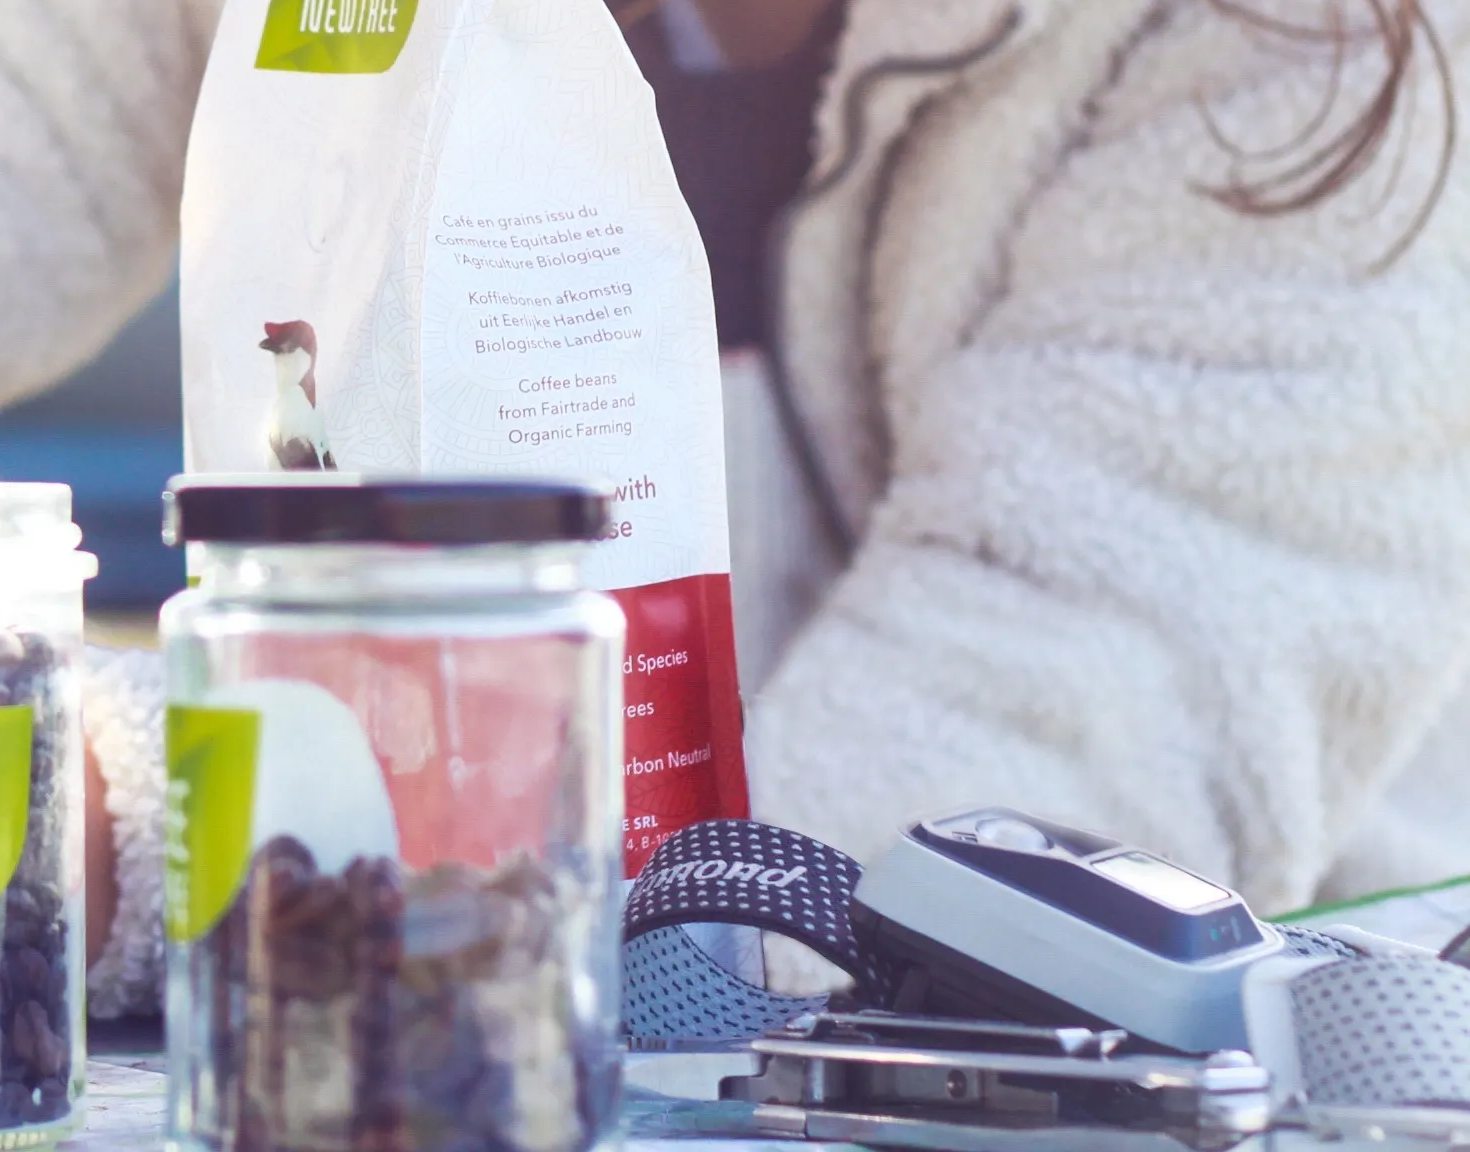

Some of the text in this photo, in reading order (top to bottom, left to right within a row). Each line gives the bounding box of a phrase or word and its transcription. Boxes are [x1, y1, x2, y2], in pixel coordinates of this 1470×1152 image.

[442, 205, 598, 230] Café en grains issu du
[435, 223, 624, 250] Commerce Equitable et de
[454, 245, 621, 269] l'Agriculture Biologique
[468, 282, 633, 307] Koffiebonen afkomstig
[479, 305, 633, 331] uit Eerlijke Handel en
[475, 328, 643, 354] Biologische Landbouw
[518, 373, 617, 393] Coffee beans
[498, 392, 636, 420] from Fairtrade and
[508, 420, 633, 446] Organic Farming
[607, 520, 633, 540] se
[637, 649, 689, 676] Species
[621, 702, 655, 719] rees
[667, 743, 713, 769] Neutral
[633, 814, 659, 830] SRL
